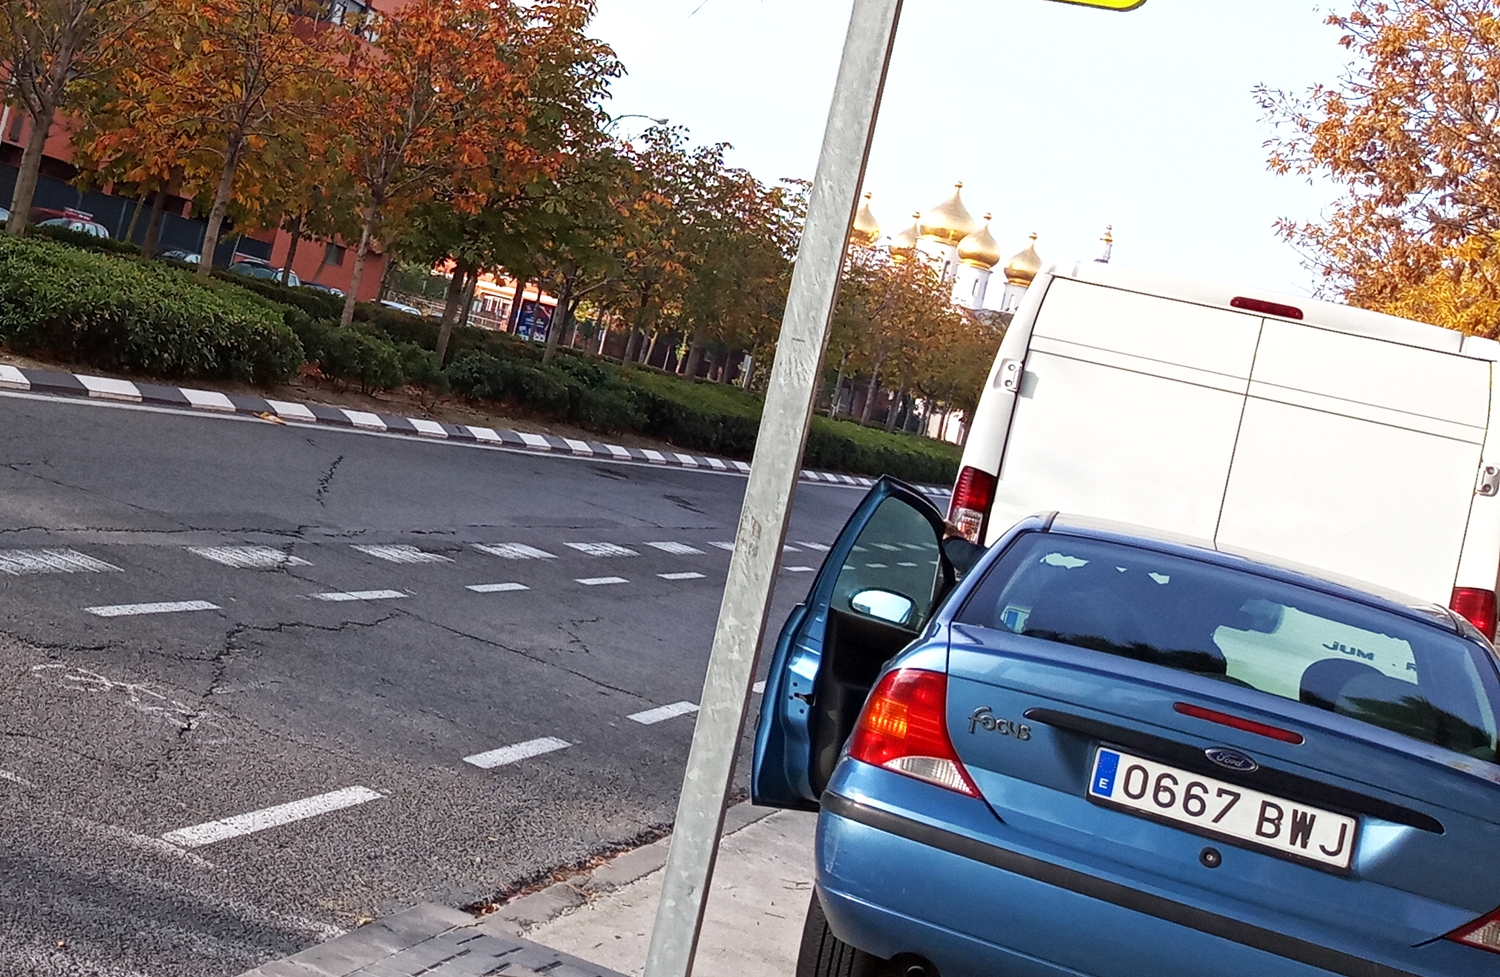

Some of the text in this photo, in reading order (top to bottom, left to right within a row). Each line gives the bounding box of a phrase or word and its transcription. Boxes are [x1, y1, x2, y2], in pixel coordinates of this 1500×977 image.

[1216, 752, 1245, 767] Ford
[1098, 764, 1348, 857] E 0667 BWJ
